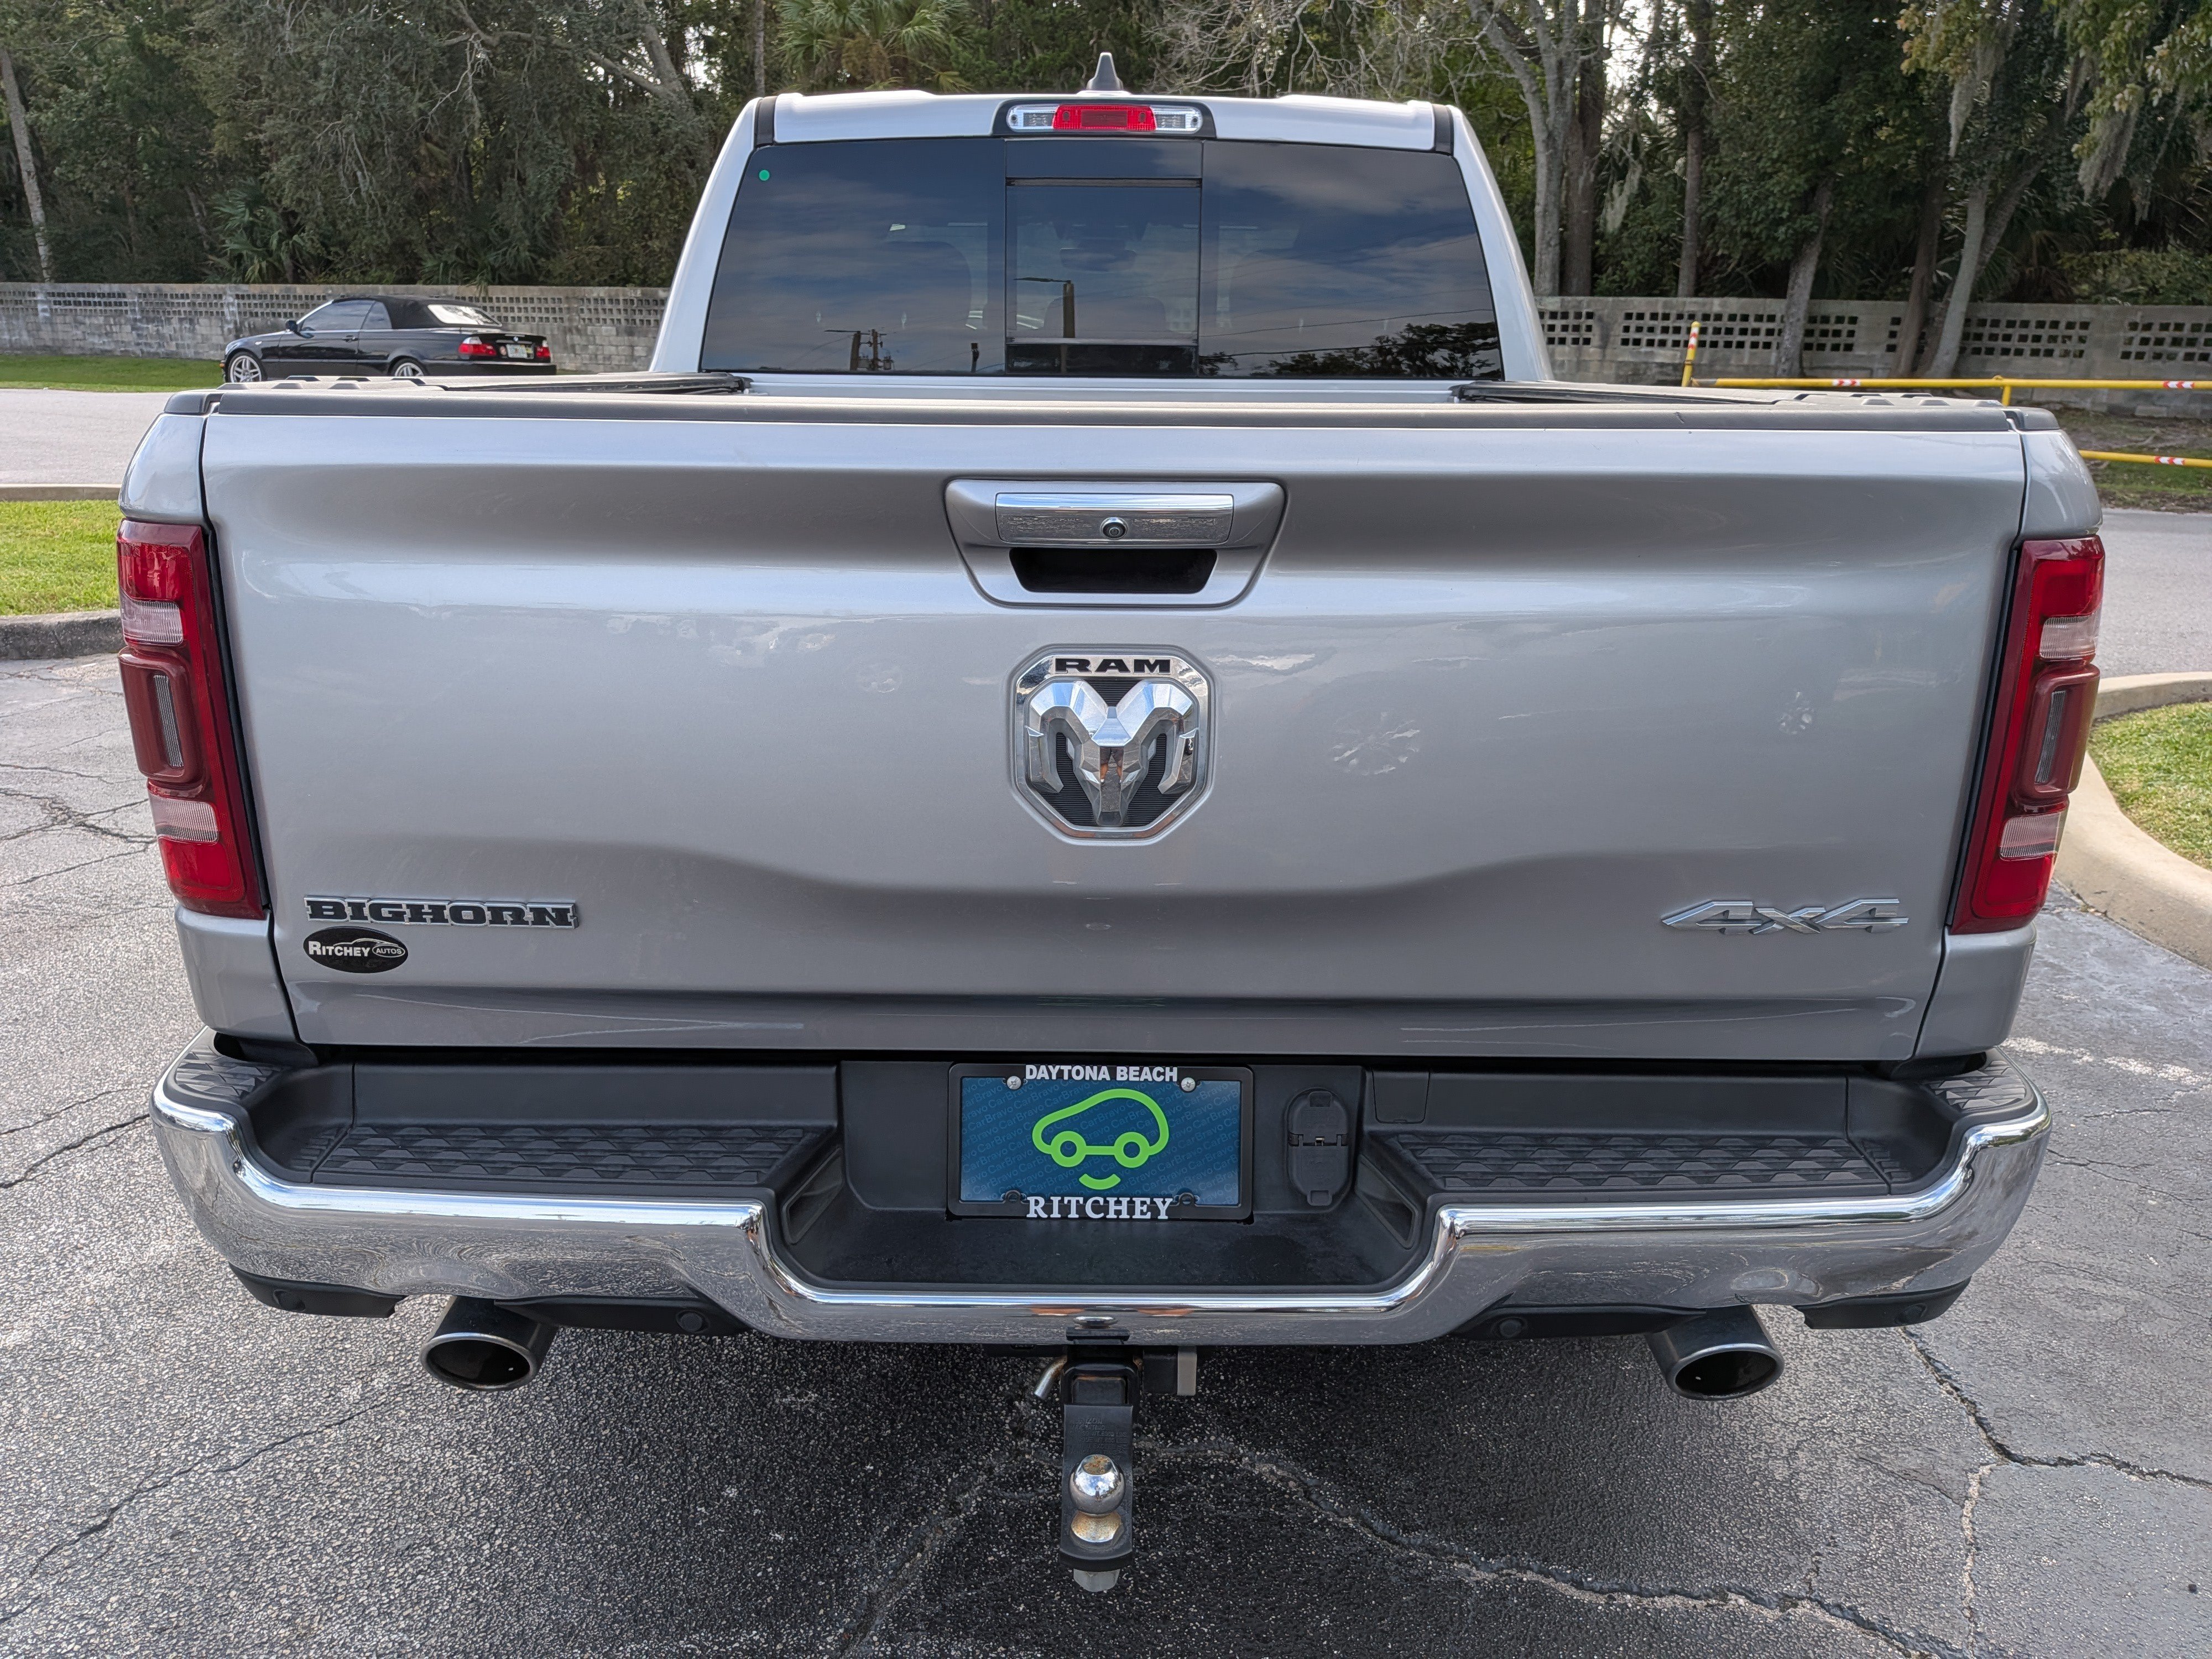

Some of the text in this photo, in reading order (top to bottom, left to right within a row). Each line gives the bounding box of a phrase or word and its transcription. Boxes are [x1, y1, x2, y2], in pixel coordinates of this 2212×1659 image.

[1055, 658, 1171, 674] RAM
[304, 895, 579, 928] BIGHORN
[1025, 1064, 1178, 1082] DAYTONA BEACH
[1026, 1196, 1174, 1220] RITCHEY
